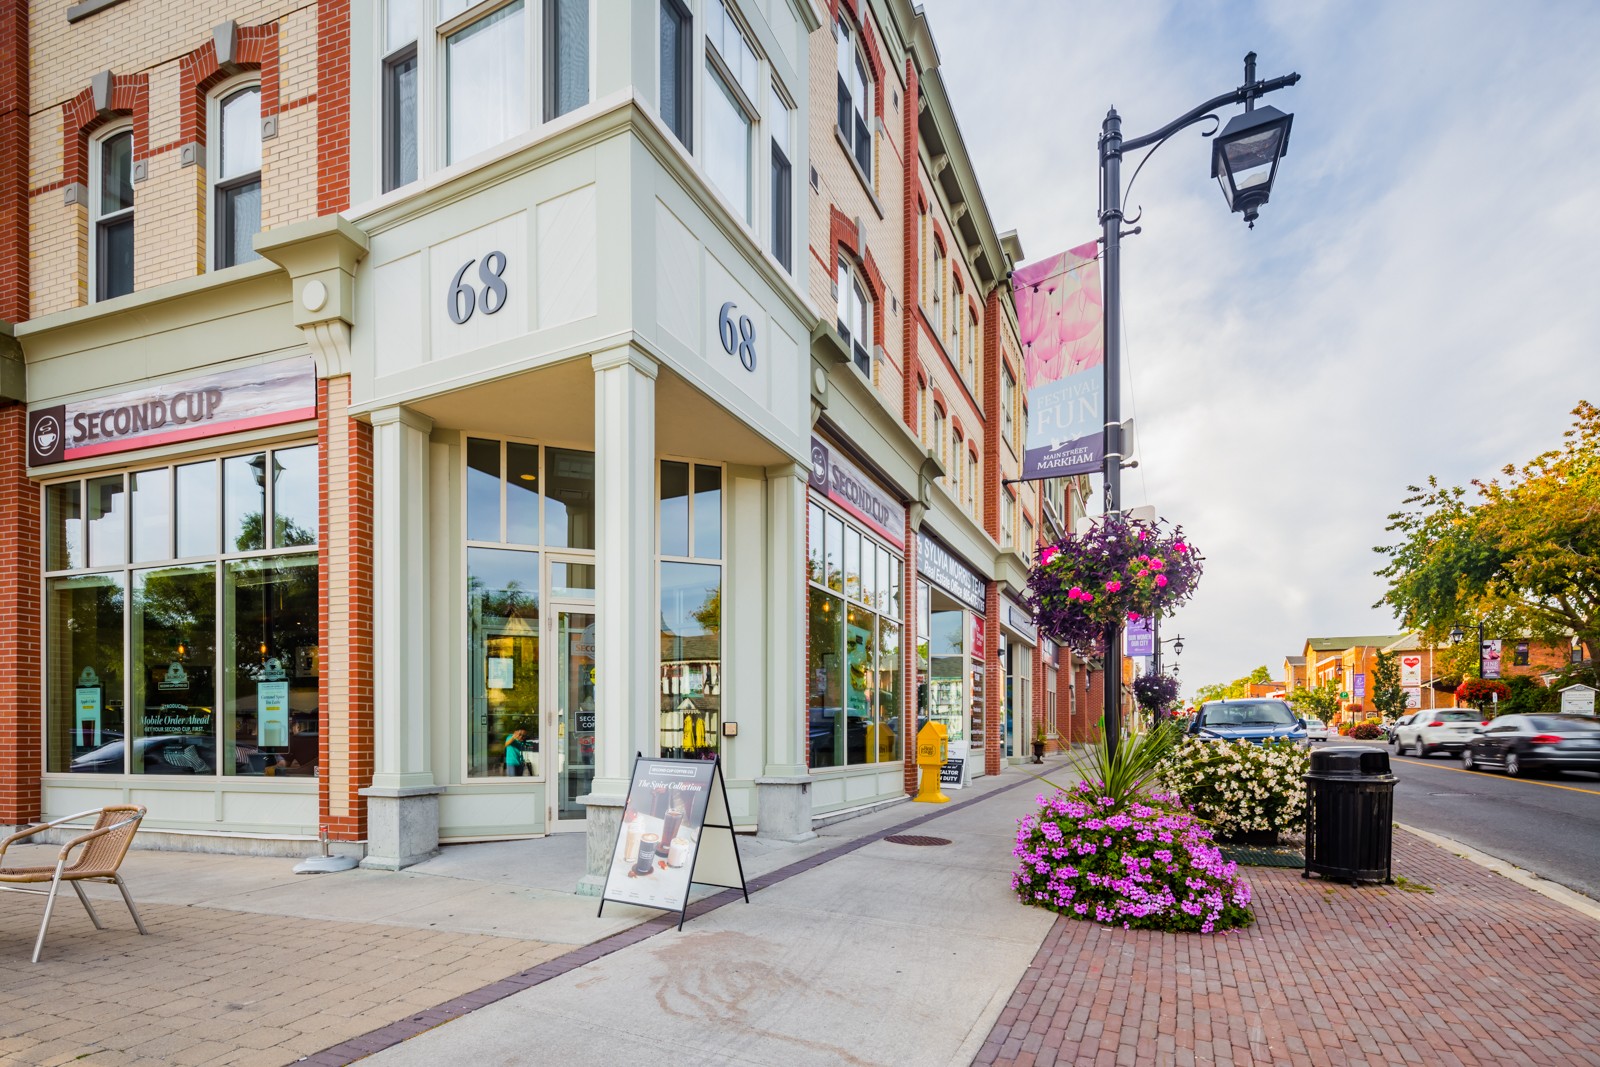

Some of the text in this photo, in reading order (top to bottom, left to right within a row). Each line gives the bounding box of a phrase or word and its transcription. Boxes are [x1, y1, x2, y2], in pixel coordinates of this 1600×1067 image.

[447, 251, 508, 325] 68
[719, 301, 757, 372] 68
[72, 389, 222, 443] SECOND CUP
[1037, 380, 1100, 409] FESTIVAL
[1037, 391, 1099, 436] FUN
[1037, 453, 1093, 470] MARKHAM
[1043, 447, 1088, 461] MAIN STREET
[832, 464, 889, 527] SECOND CUP
[925, 538, 948, 573] SYLVIA
[949, 557, 971, 589] MORRIS
[971, 575, 985, 599] TEAM
[141, 715, 210, 725] Mobile Order Ahead
[639, 780, 701, 791] The Spice Collection
